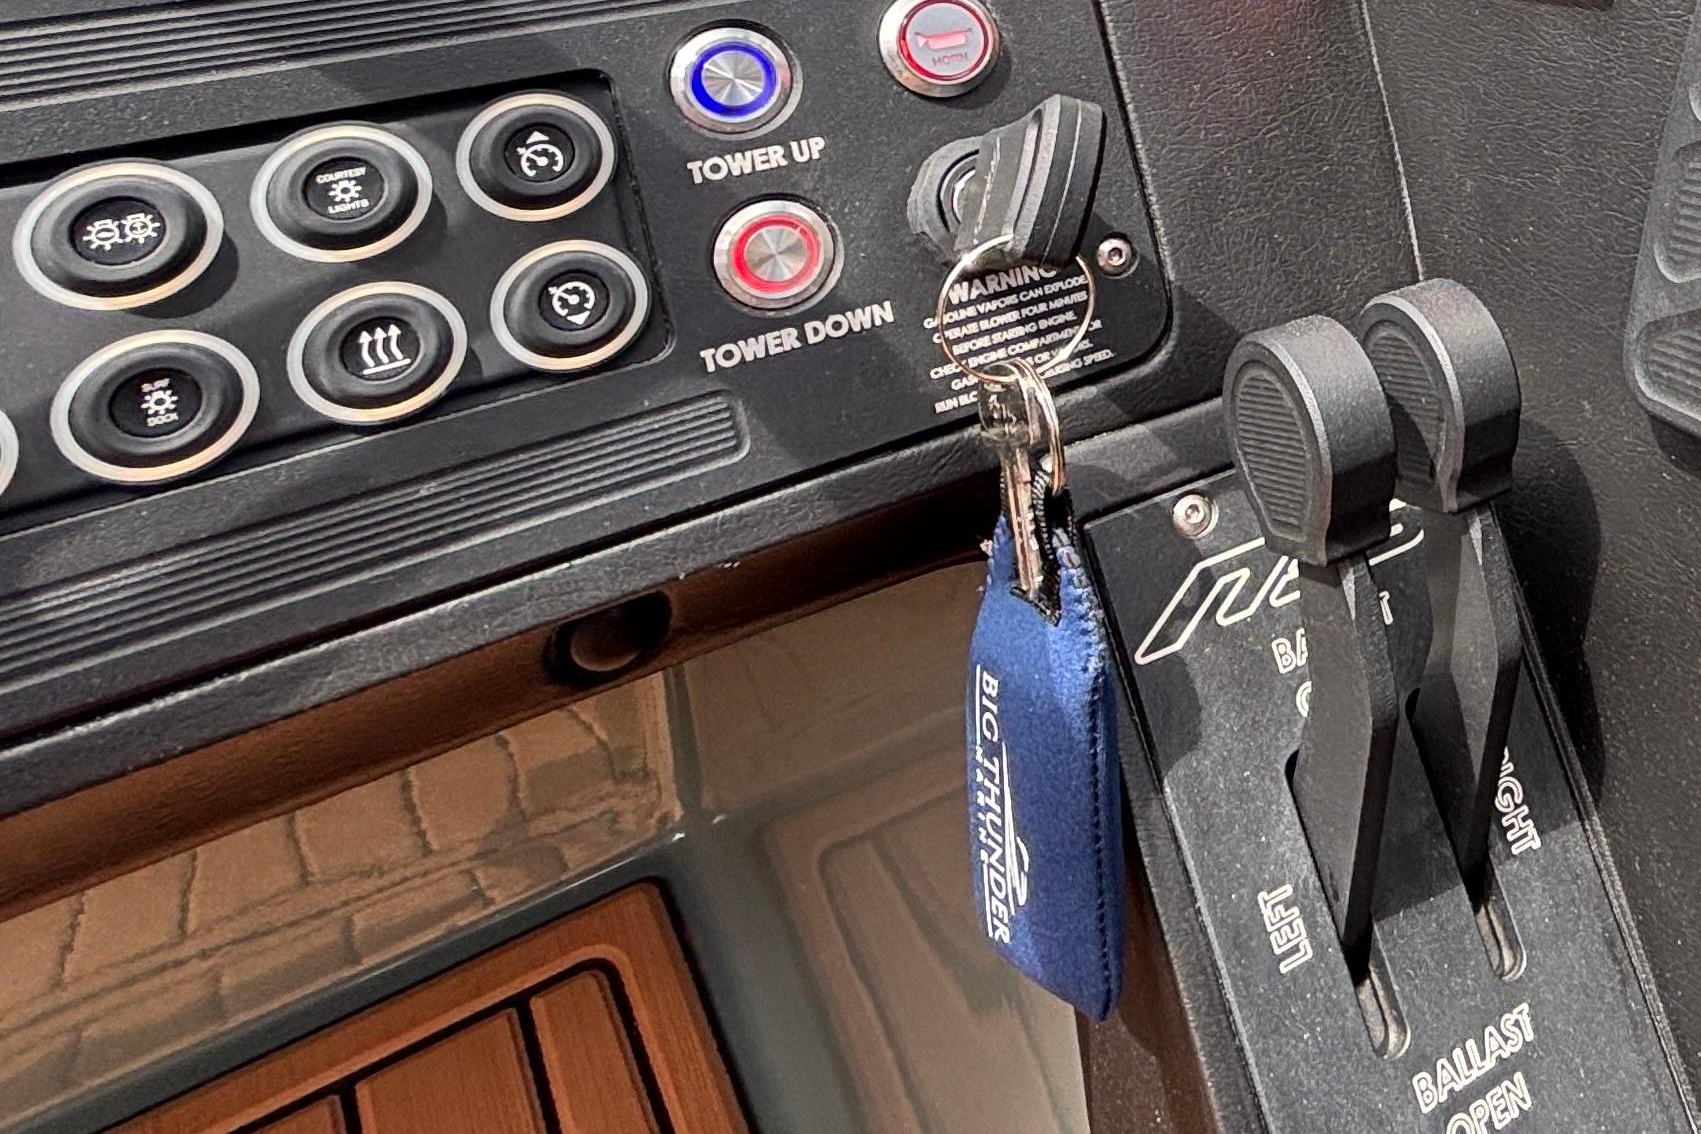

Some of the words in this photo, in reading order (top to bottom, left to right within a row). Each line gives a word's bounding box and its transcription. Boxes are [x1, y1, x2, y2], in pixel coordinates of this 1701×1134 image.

[687, 143, 789, 184] TOWER
[792, 136, 826, 162] UP
[327, 199, 370, 213] LIGHTS
[1019, 286, 1043, 302] CAN
[1021, 302, 1048, 318] FOUR
[1049, 290, 1088, 310] MINUTES
[700, 330, 801, 373] TOWER
[803, 301, 894, 344] DOWN
[952, 335, 992, 355] BEFORE
[991, 322, 1038, 344] STARTING
[968, 347, 1007, 368] ENGINE
[935, 396, 958, 413] RUN
[982, 669, 999, 742] BIG
[1495, 746, 1541, 855] IGHT
[983, 756, 1011, 945] THUNDER
[1257, 884, 1313, 974] LEFT
[1412, 1002, 1534, 1114] BALLAST
